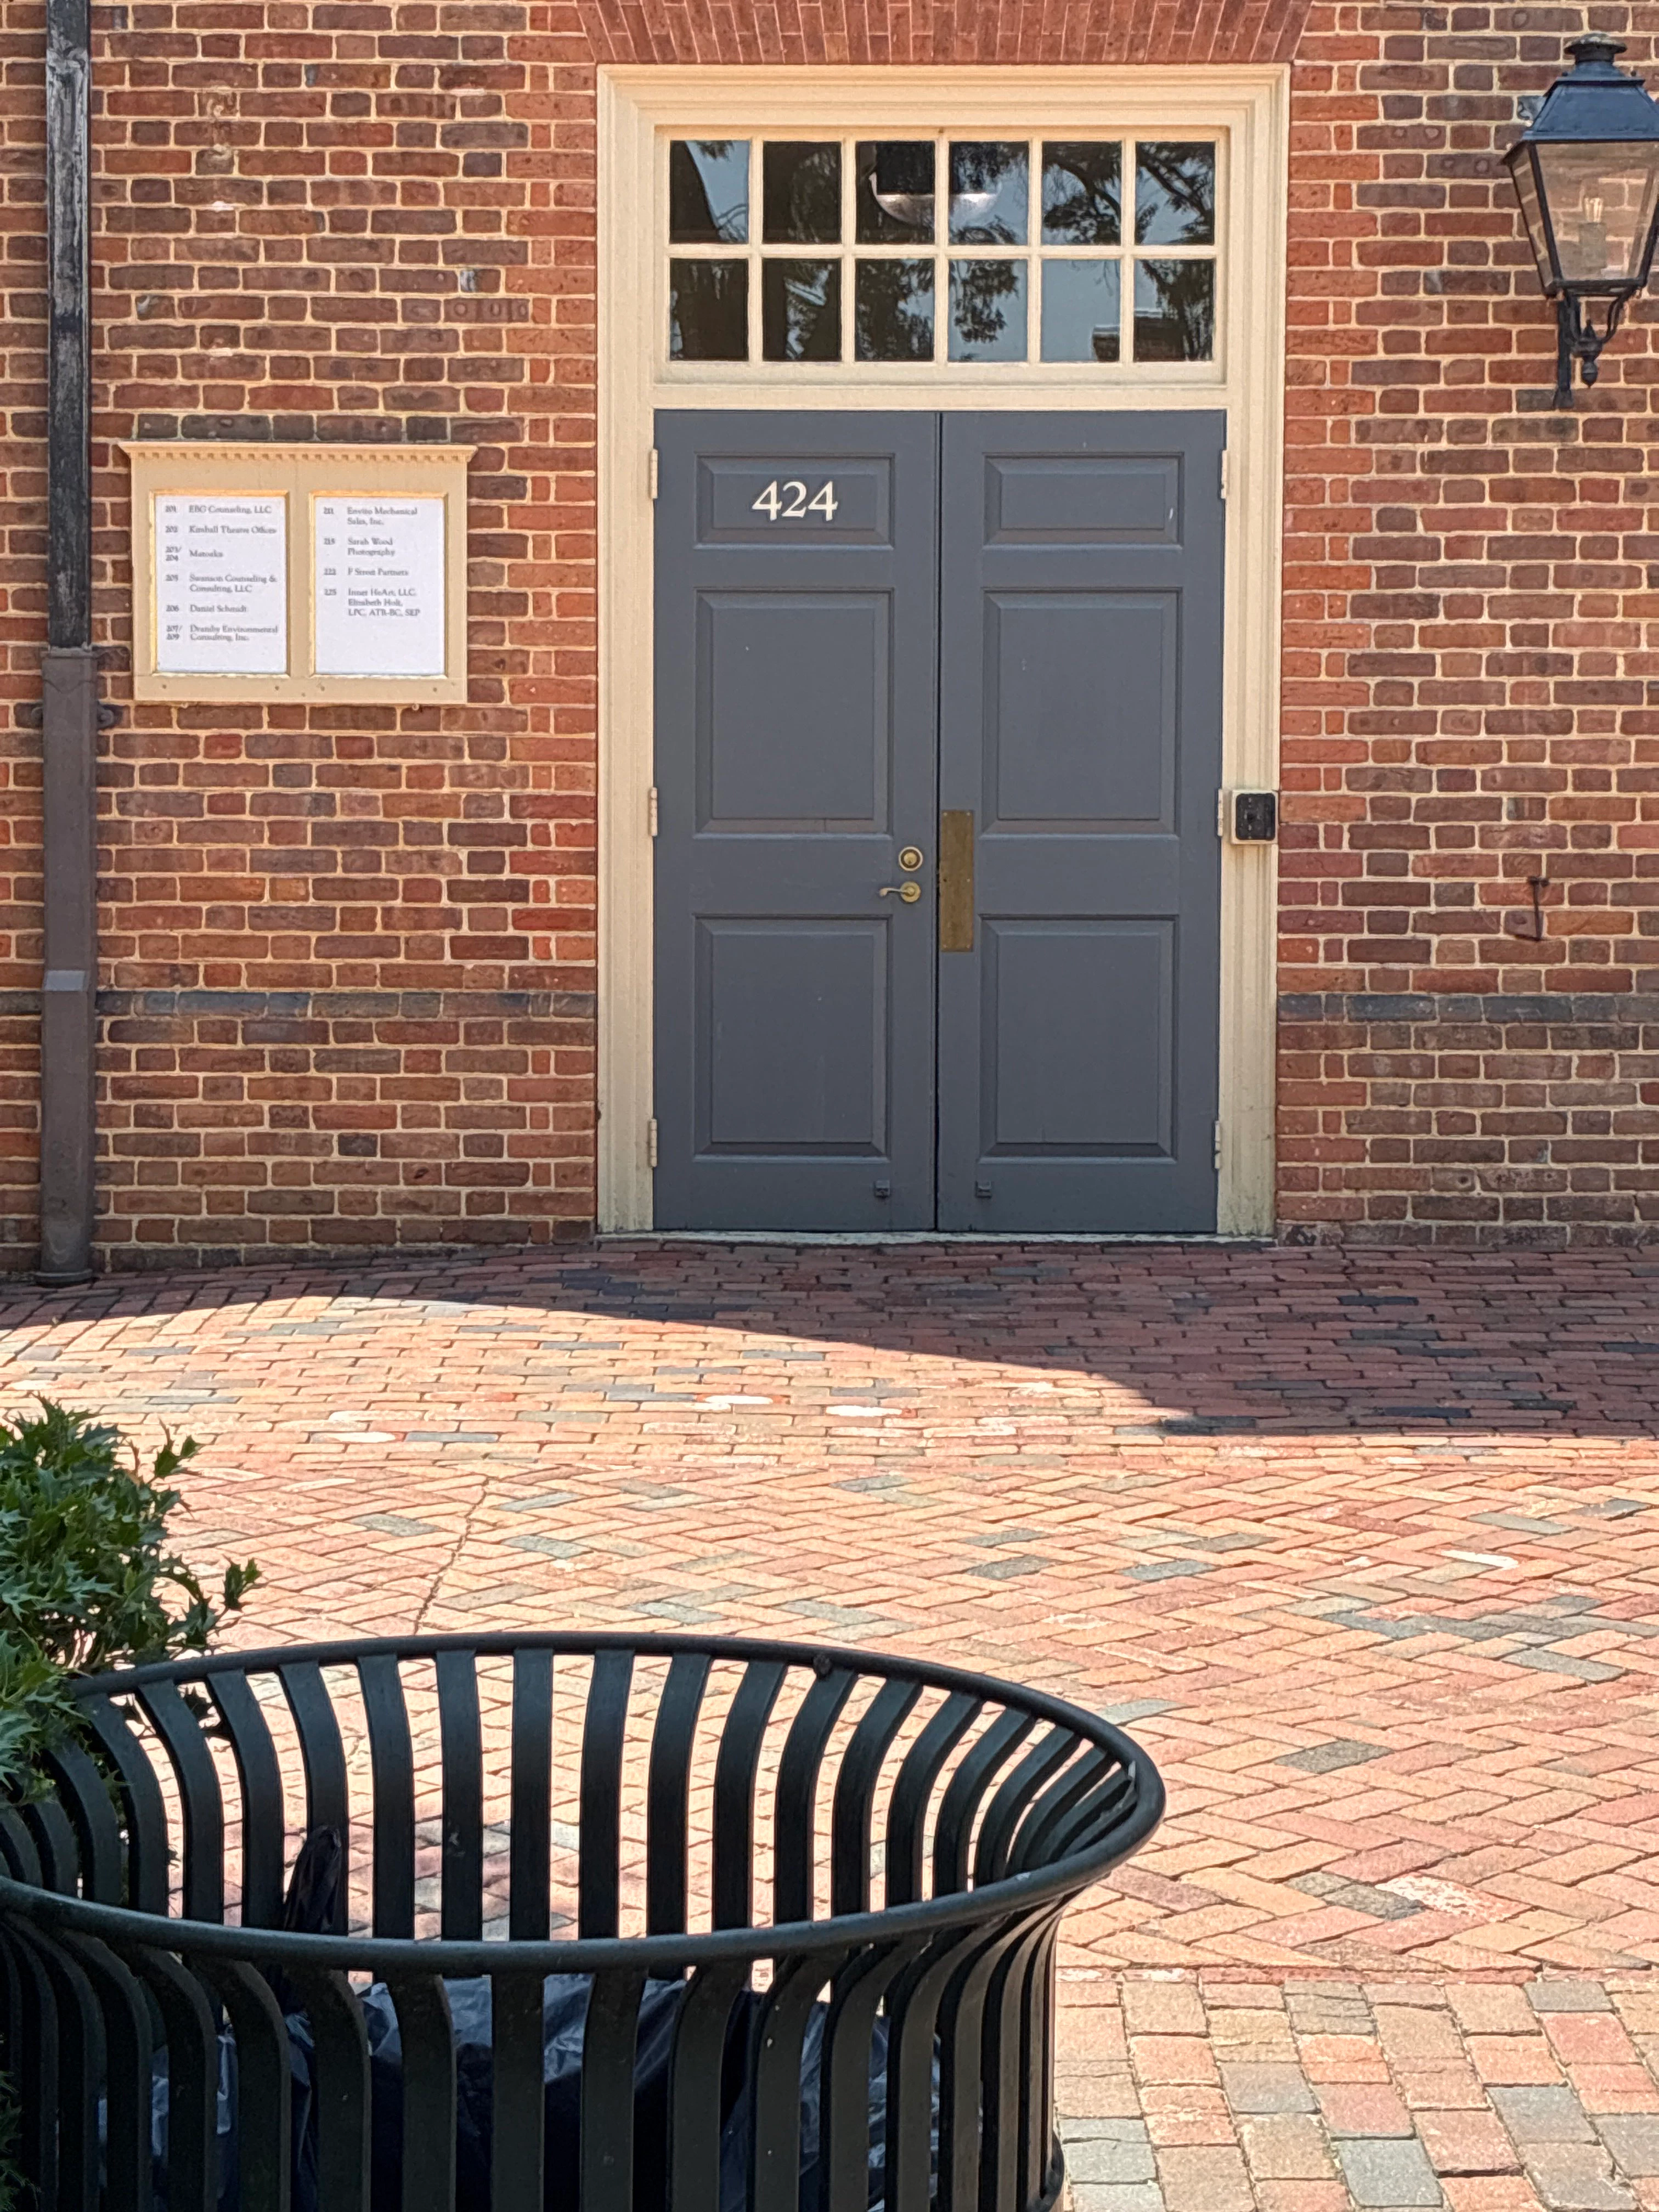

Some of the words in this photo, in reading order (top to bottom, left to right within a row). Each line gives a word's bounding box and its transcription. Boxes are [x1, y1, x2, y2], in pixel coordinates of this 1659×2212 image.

[752, 481, 838, 521] 424
[189, 505, 206, 513] EBG
[255, 505, 272, 514] LLC
[347, 506, 373, 515] Enviro
[374, 506, 417, 515] Mechanical
[347, 517, 368, 526] Sales,
[189, 525, 218, 534] Kimball
[221, 525, 249, 534] Theatre
[251, 525, 276, 534] Offices
[190, 549, 223, 557] Matoaka
[347, 547, 396, 556] Photography
[190, 573, 223, 582] Swanson
[224, 574, 267, 584] Counseling
[235, 584, 252, 593] LLC
[348, 588, 368, 596] Inner
[166, 604, 179, 612] 206
[190, 604, 215, 612] Daniel
[222, 625, 278, 633] Environmental
